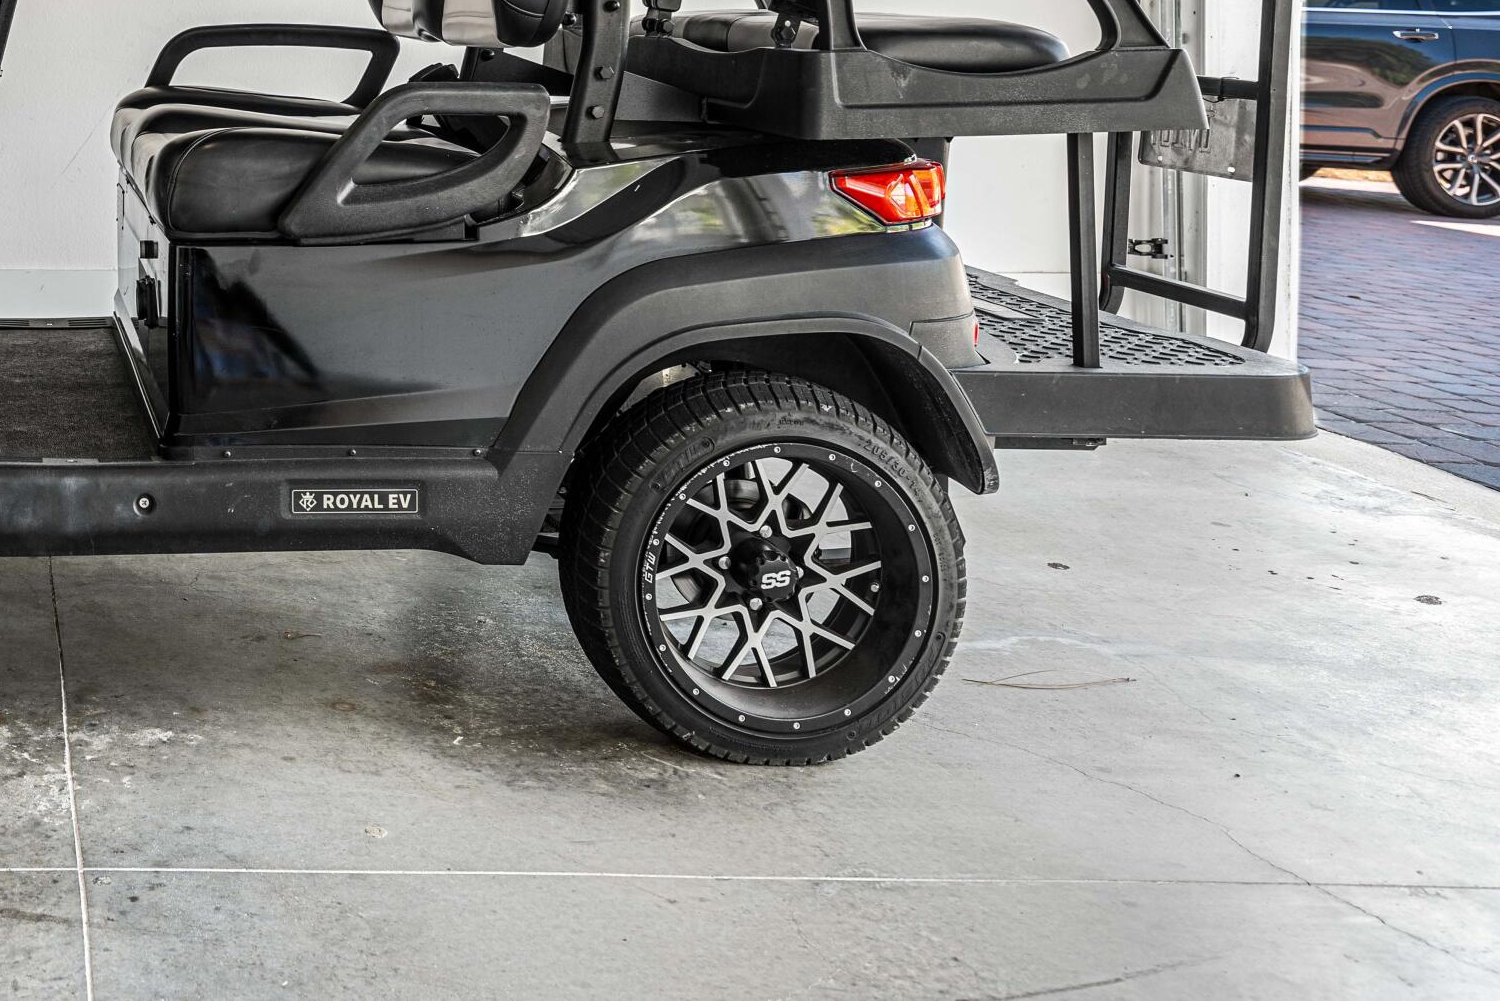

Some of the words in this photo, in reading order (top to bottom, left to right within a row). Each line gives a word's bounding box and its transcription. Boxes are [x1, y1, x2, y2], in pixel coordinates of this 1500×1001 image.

[323, 494, 383, 509] ROYAL
[389, 494, 411, 508] EV
[644, 552, 656, 584] GTW
[761, 570, 791, 590] SS
